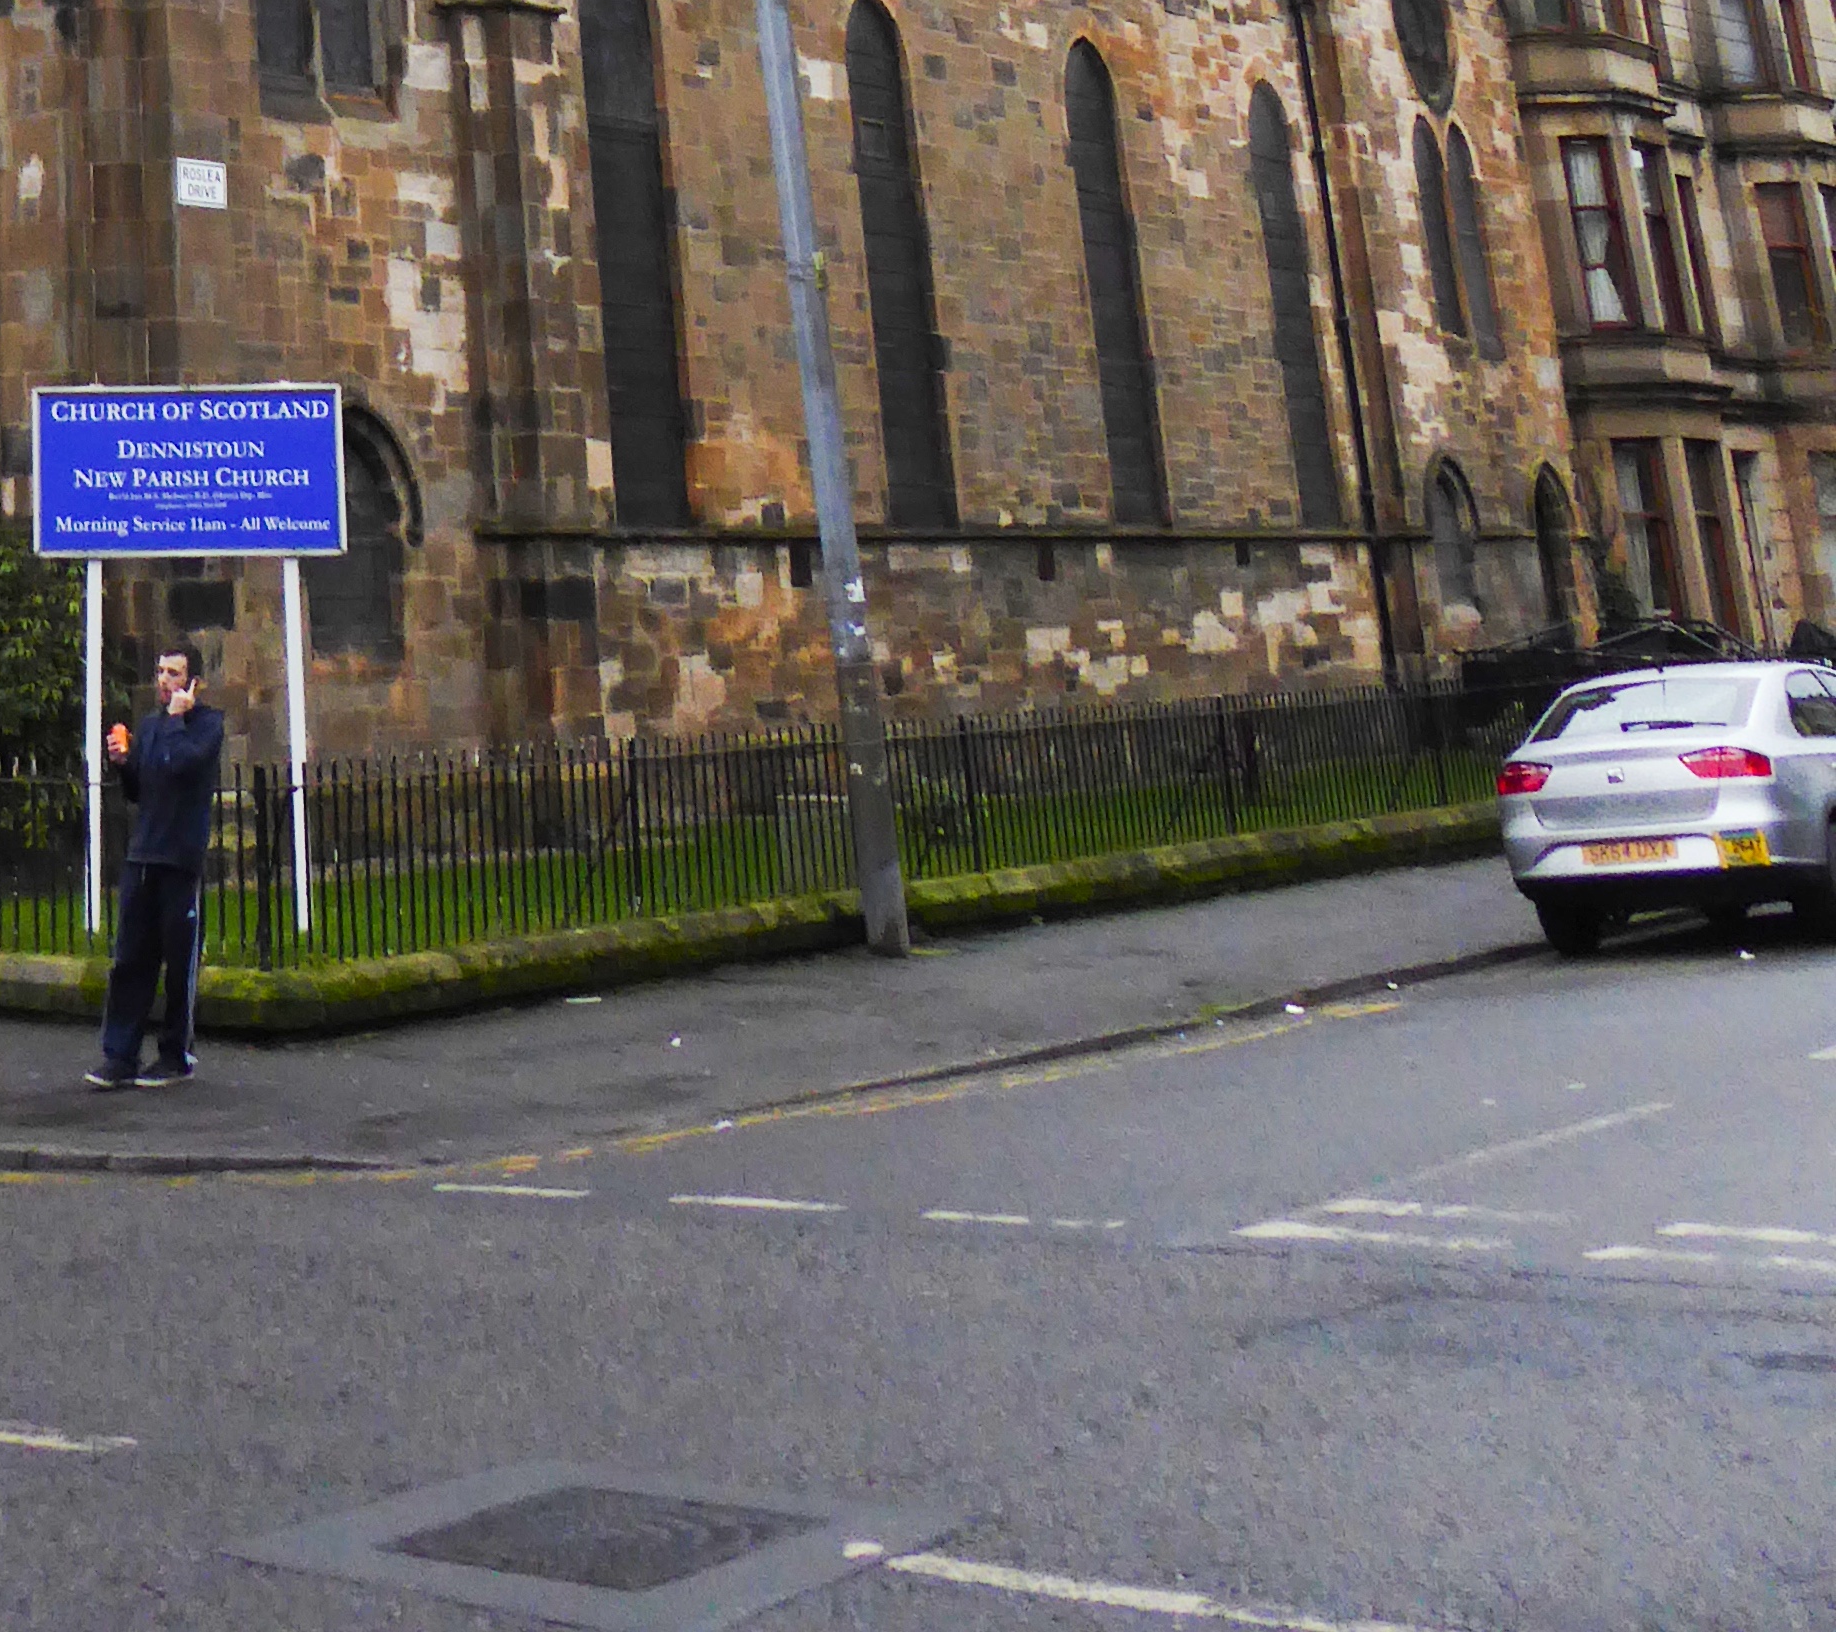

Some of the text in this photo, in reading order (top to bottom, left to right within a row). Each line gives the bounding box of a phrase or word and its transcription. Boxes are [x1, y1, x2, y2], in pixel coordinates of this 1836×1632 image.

[182, 166, 221, 183] ROSLEA
[188, 183, 217, 199] DRIVE
[161, 401, 195, 421] OF
[200, 399, 329, 420] SCOTLAND
[117, 439, 265, 459] DENNISTOUN
[73, 466, 310, 489] NEW PARISH CHURCH
[55, 515, 129, 537] Morning
[133, 517, 186, 532] Service
[240, 516, 261, 531] All
[265, 516, 331, 531] Welcome
